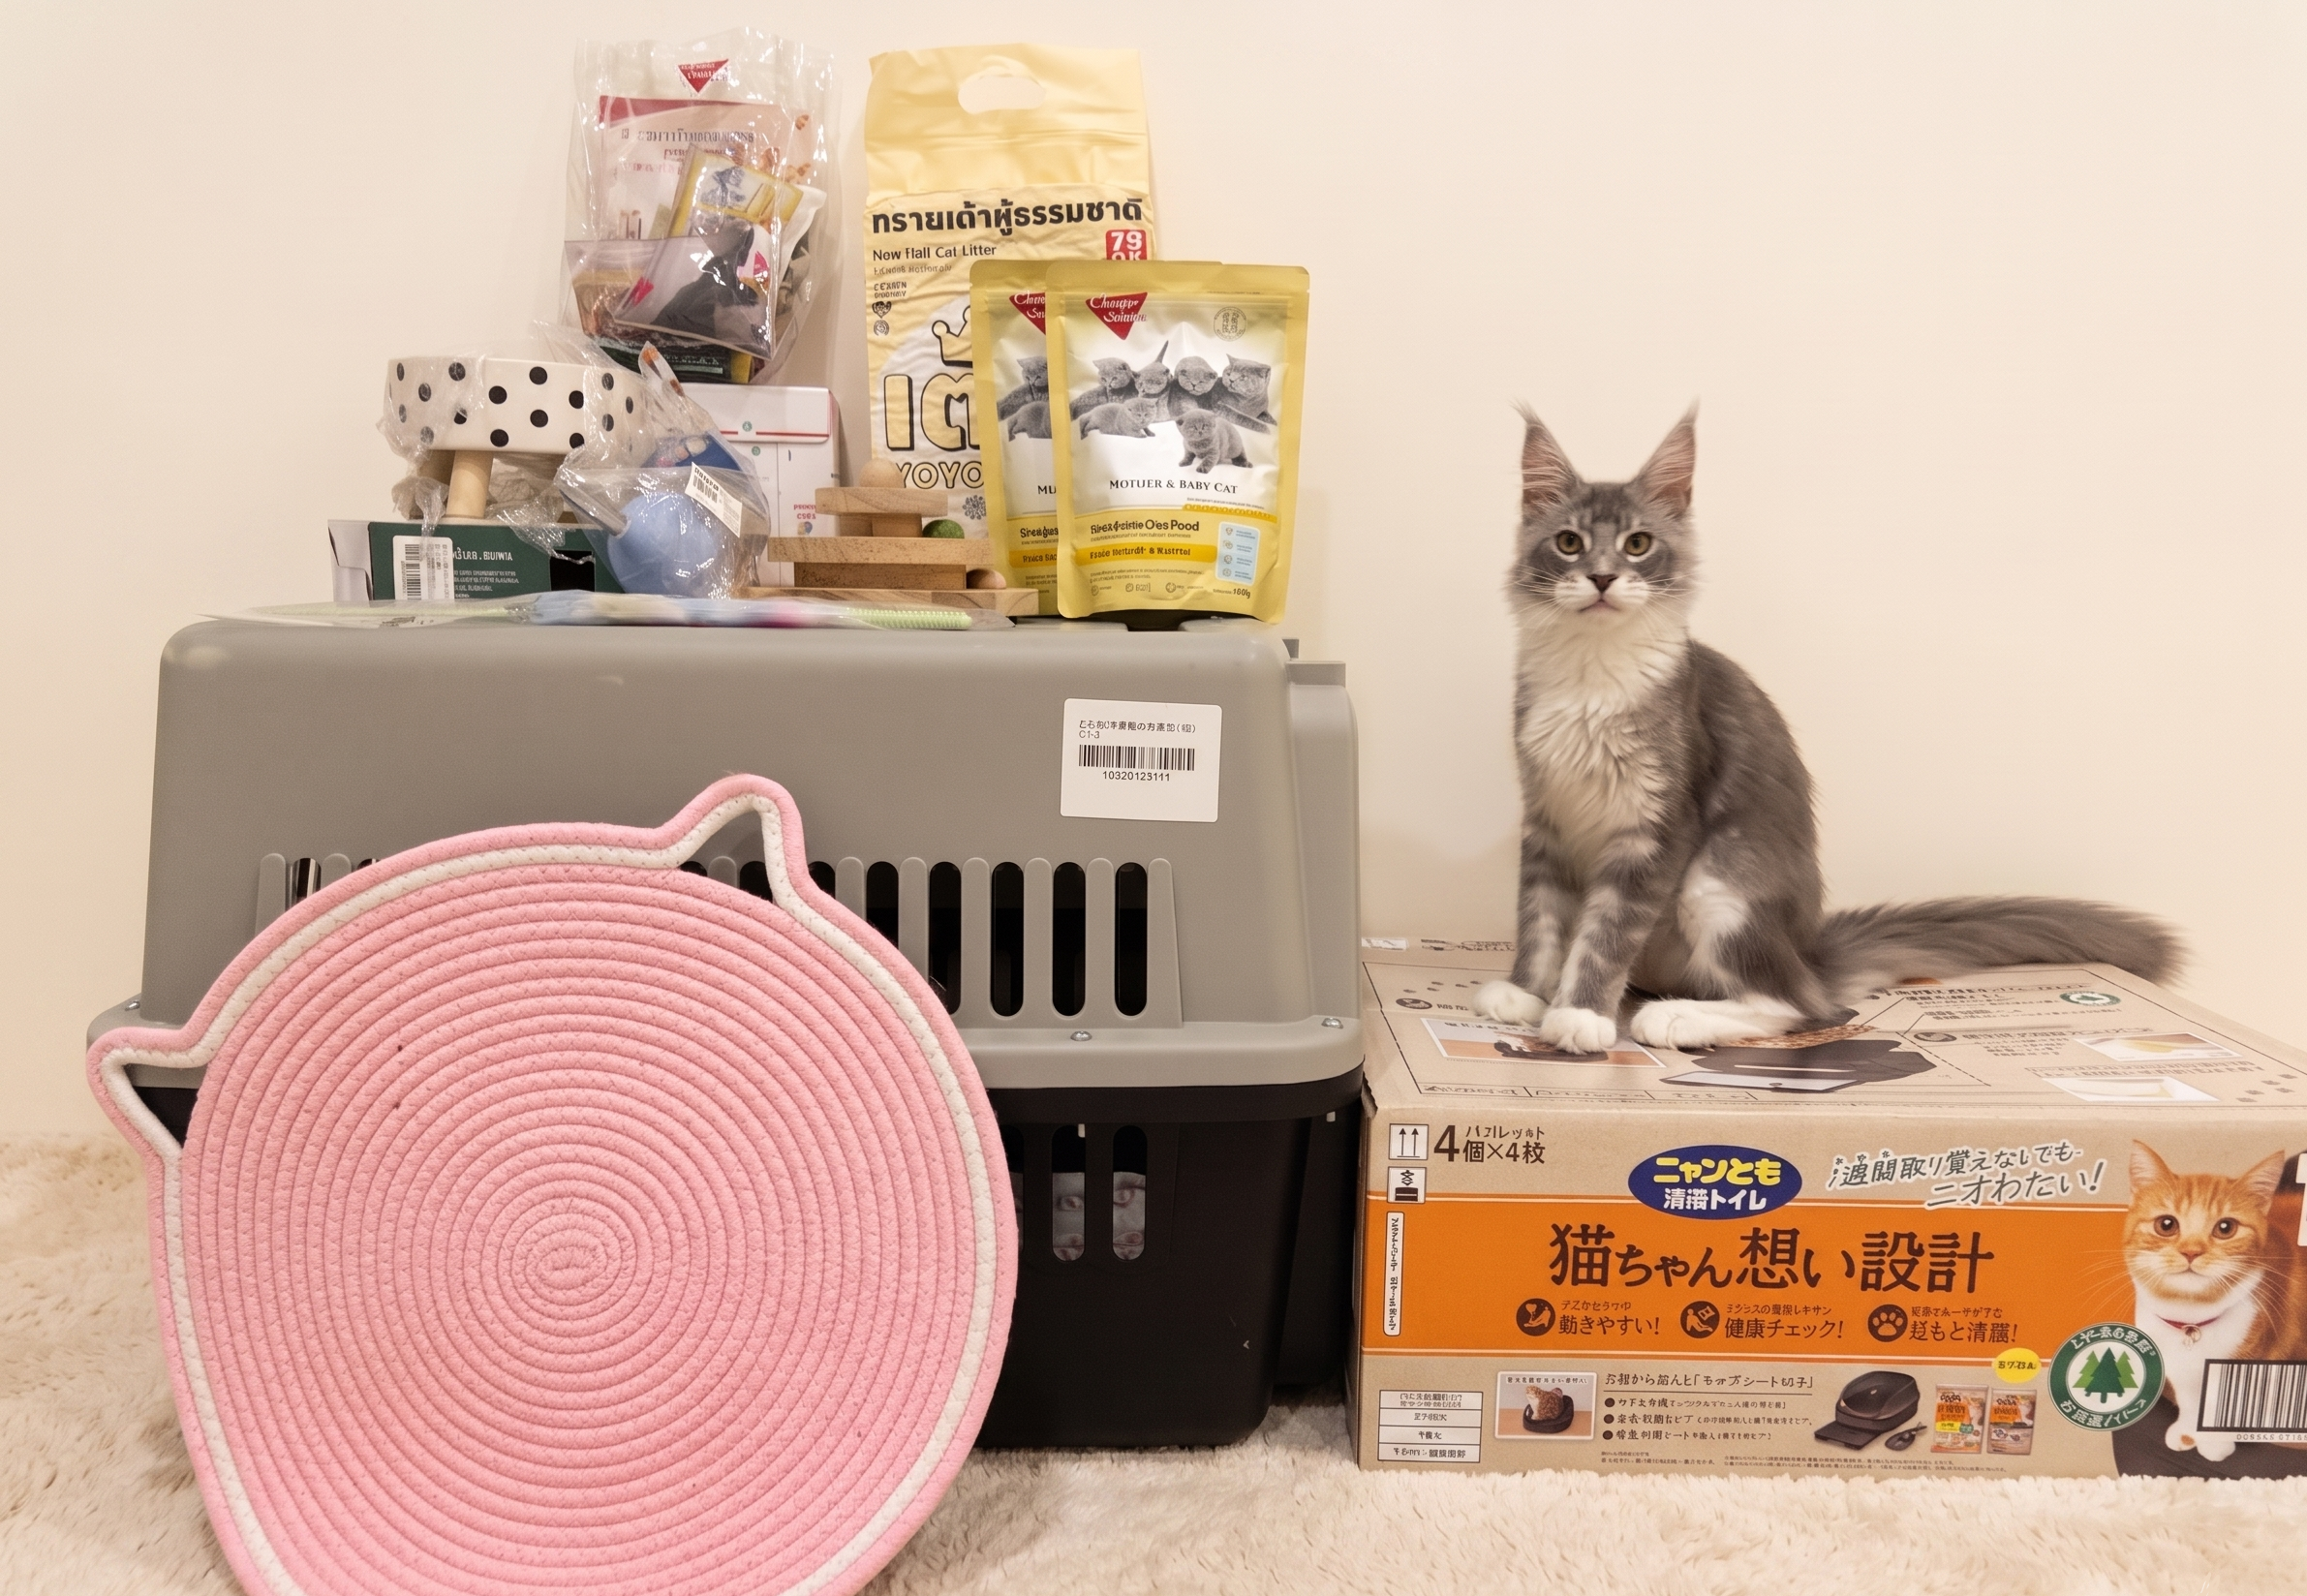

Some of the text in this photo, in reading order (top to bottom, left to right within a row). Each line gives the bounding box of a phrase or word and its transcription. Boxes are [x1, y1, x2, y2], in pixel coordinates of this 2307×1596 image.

[936, 246, 957, 259] Cat
[962, 244, 997, 257] Litter
[1166, 479, 1176, 489] &
[1180, 479, 1211, 491] BABY
[1214, 482, 1238, 494] CAT
[1653, 1157, 1781, 1186] ニャンとも
[1550, 1223, 1995, 1293] 猫ちゃん想い設計
